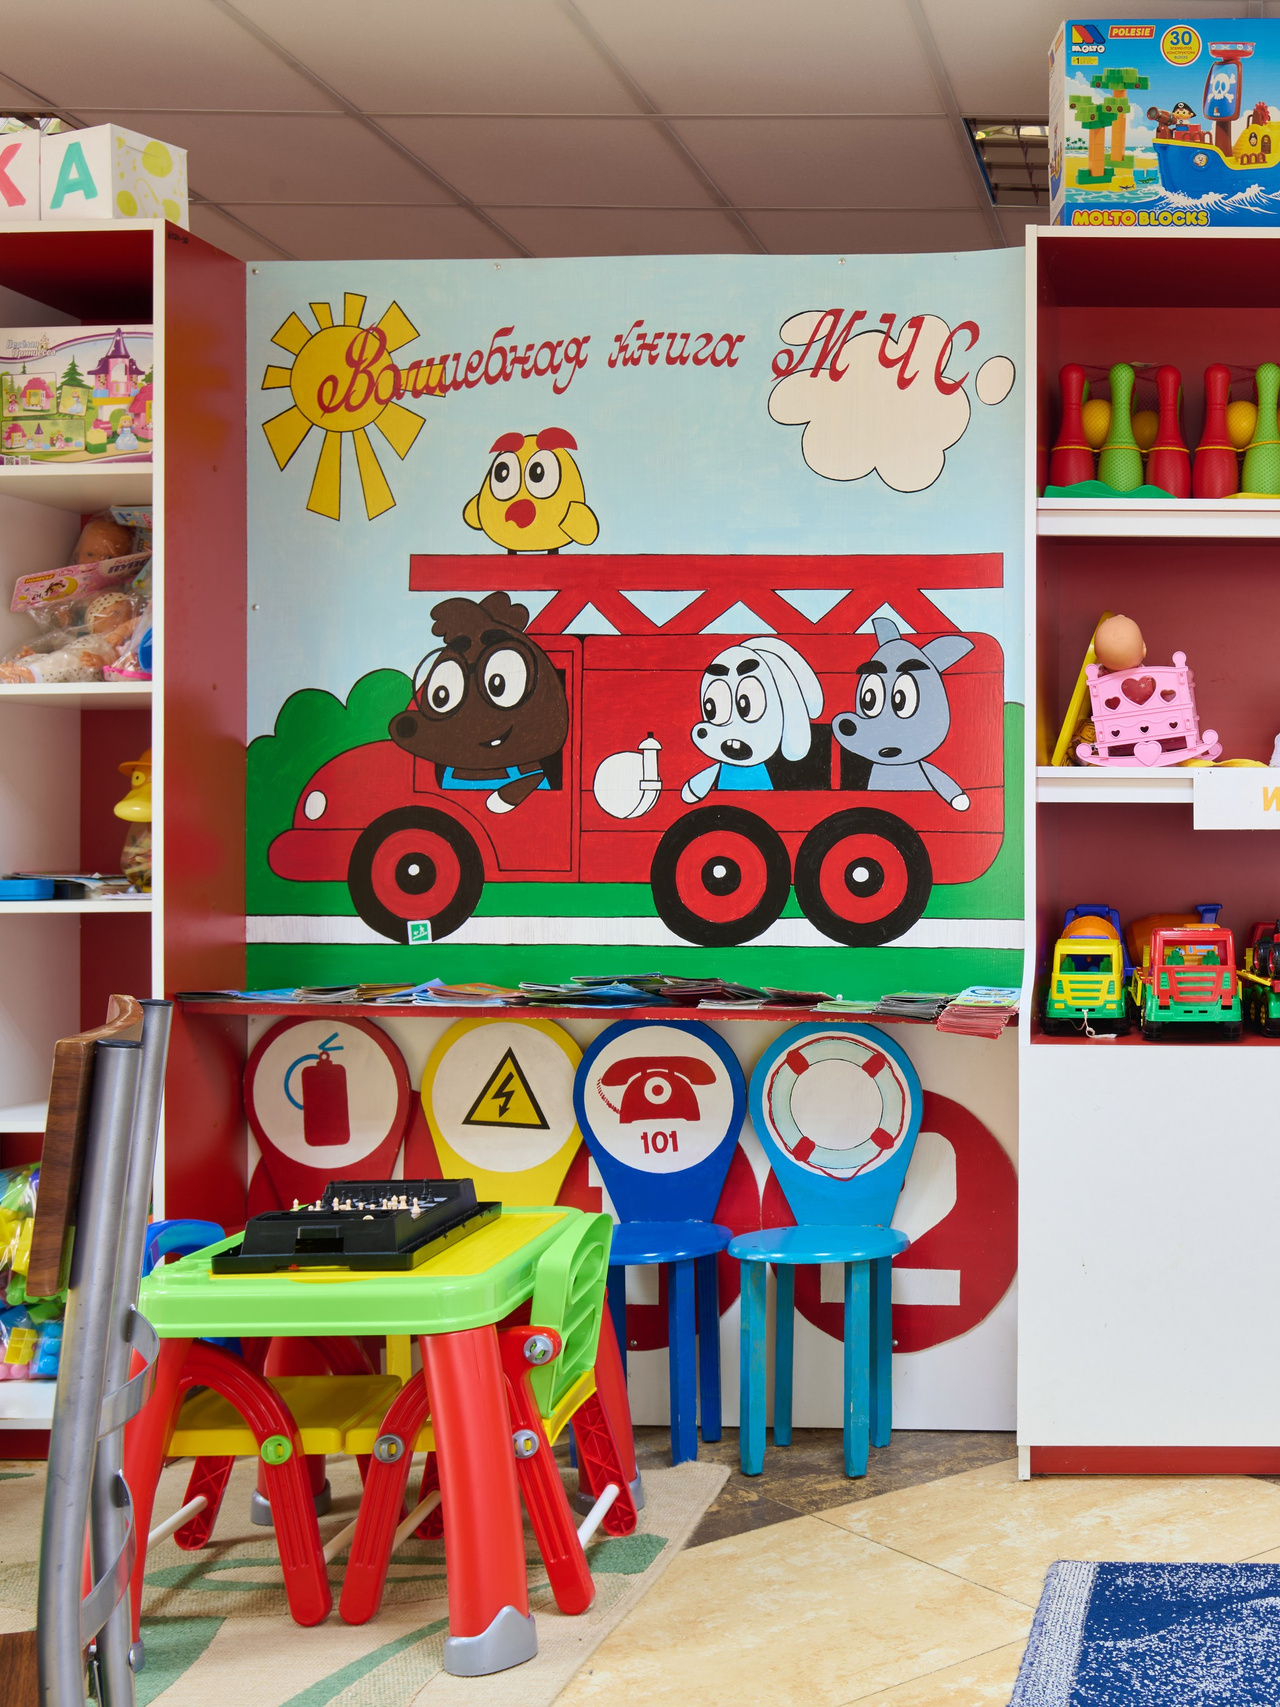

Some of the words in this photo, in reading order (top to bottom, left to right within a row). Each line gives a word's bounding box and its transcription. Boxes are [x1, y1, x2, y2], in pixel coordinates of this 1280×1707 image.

[1111, 28, 1151, 37] POLESIE
[1170, 30, 1193, 46] 30
[1072, 209, 1137, 227] MOLTO
[1137, 209, 1210, 227] BLOCKS
[317, 322, 592, 418] Волшебная
[607, 319, 745, 368] книга
[771, 308, 980, 395] МЧС
[640, 1130, 679, 1155] 101
